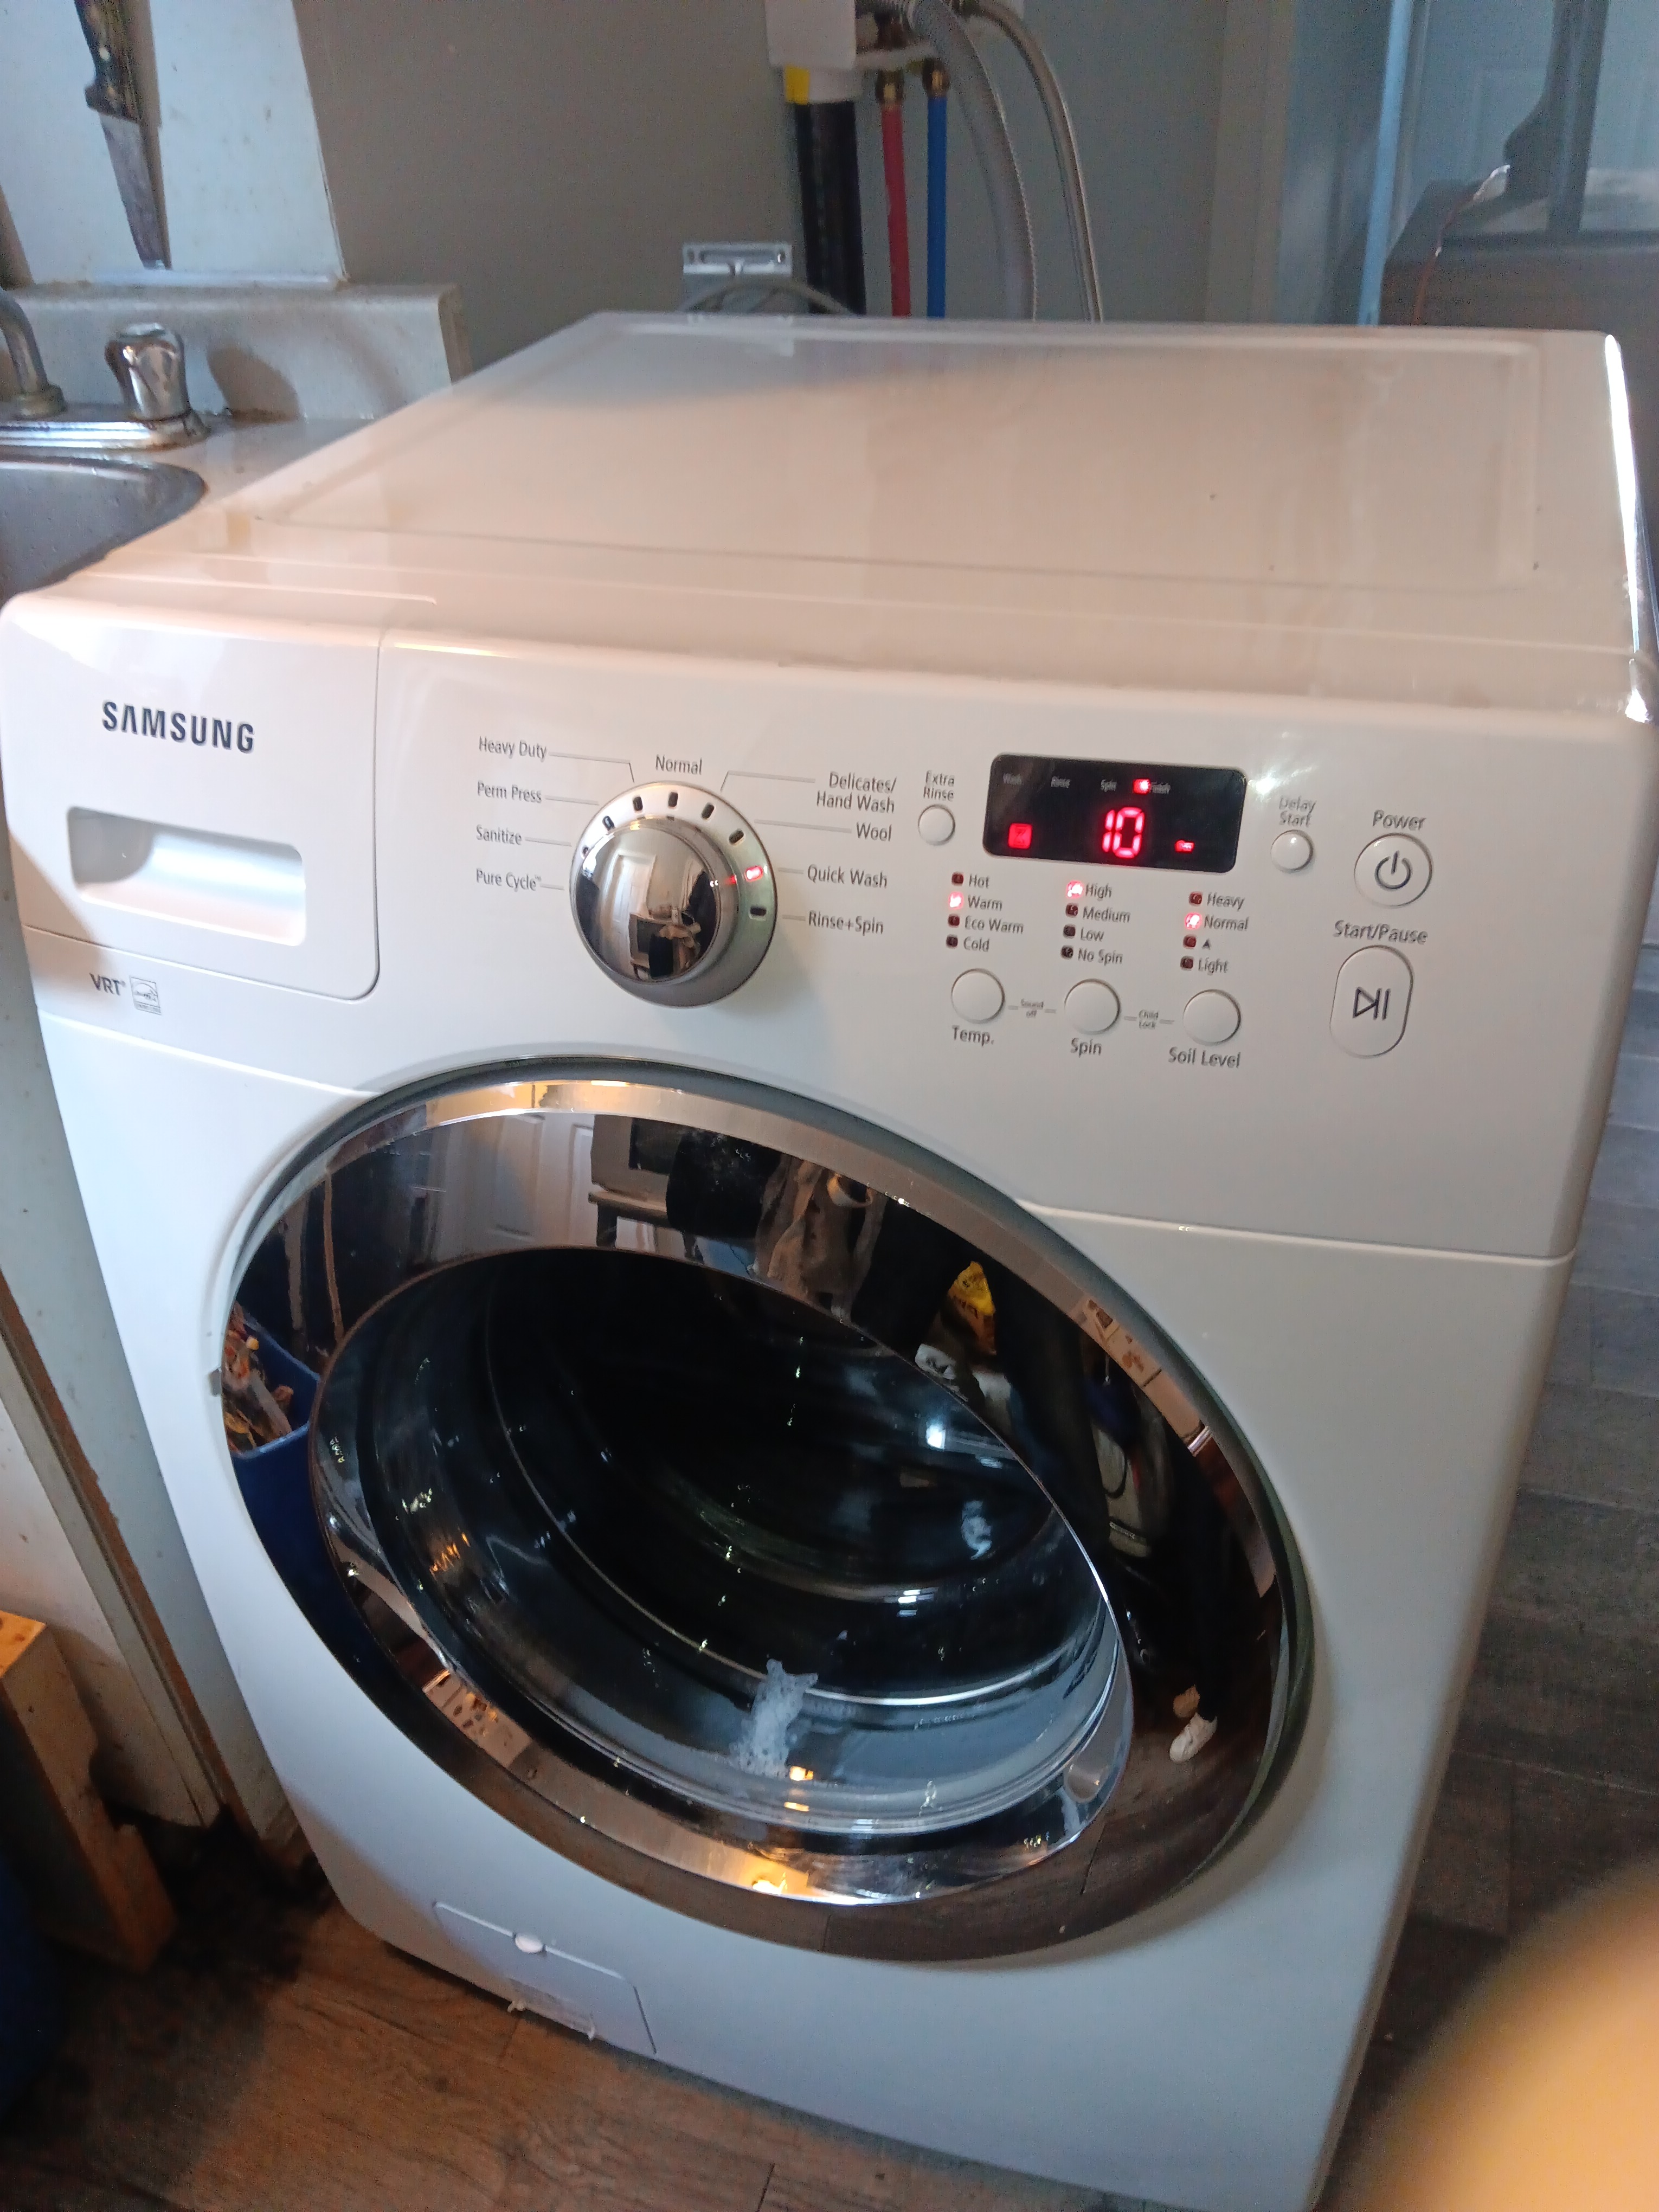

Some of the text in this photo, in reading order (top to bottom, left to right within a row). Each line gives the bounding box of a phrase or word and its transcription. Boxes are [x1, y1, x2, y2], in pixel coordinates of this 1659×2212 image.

[101, 699, 255, 754] SAMSUNG
[478, 736, 548, 762] Heavy Duty
[655, 755, 703, 776] Normal
[829, 772, 897, 794] Delicates/
[925, 770, 955, 787] Extra
[477, 781, 542, 804] Perm Press
[816, 790, 895, 814] Hand Wash
[923, 787, 954, 802] Rinse
[1278, 795, 1317, 814] Delay
[1279, 812, 1311, 827] Start
[1373, 809, 1426, 830] Power
[475, 824, 523, 846] Sanitize
[856, 822, 892, 841] Wool
[1102, 807, 1144, 858] 10
[475, 867, 503, 888] Pure
[807, 865, 888, 889] Quick Wash
[968, 874, 991, 889] Hot
[1085, 883, 1113, 900] High
[967, 895, 1003, 911] Warm
[1207, 892, 1245, 911] Heavy
[808, 910, 884, 936] Rinse+Spin
[1083, 906, 1130, 923] Medium
[1204, 915, 1249, 931] Normal
[964, 916, 1024, 935] Eco Warm
[1080, 927, 1105, 943] Low
[1334, 920, 1429, 944] Start/Pause
[962, 936, 991, 953] Cold
[1078, 948, 1123, 966] No Spin
[1197, 957, 1229, 974] Light
[952, 1025, 995, 1046] Temp.
[1071, 1039, 1102, 1056] Spin
[1168, 1047, 1241, 1069] Soil Level
